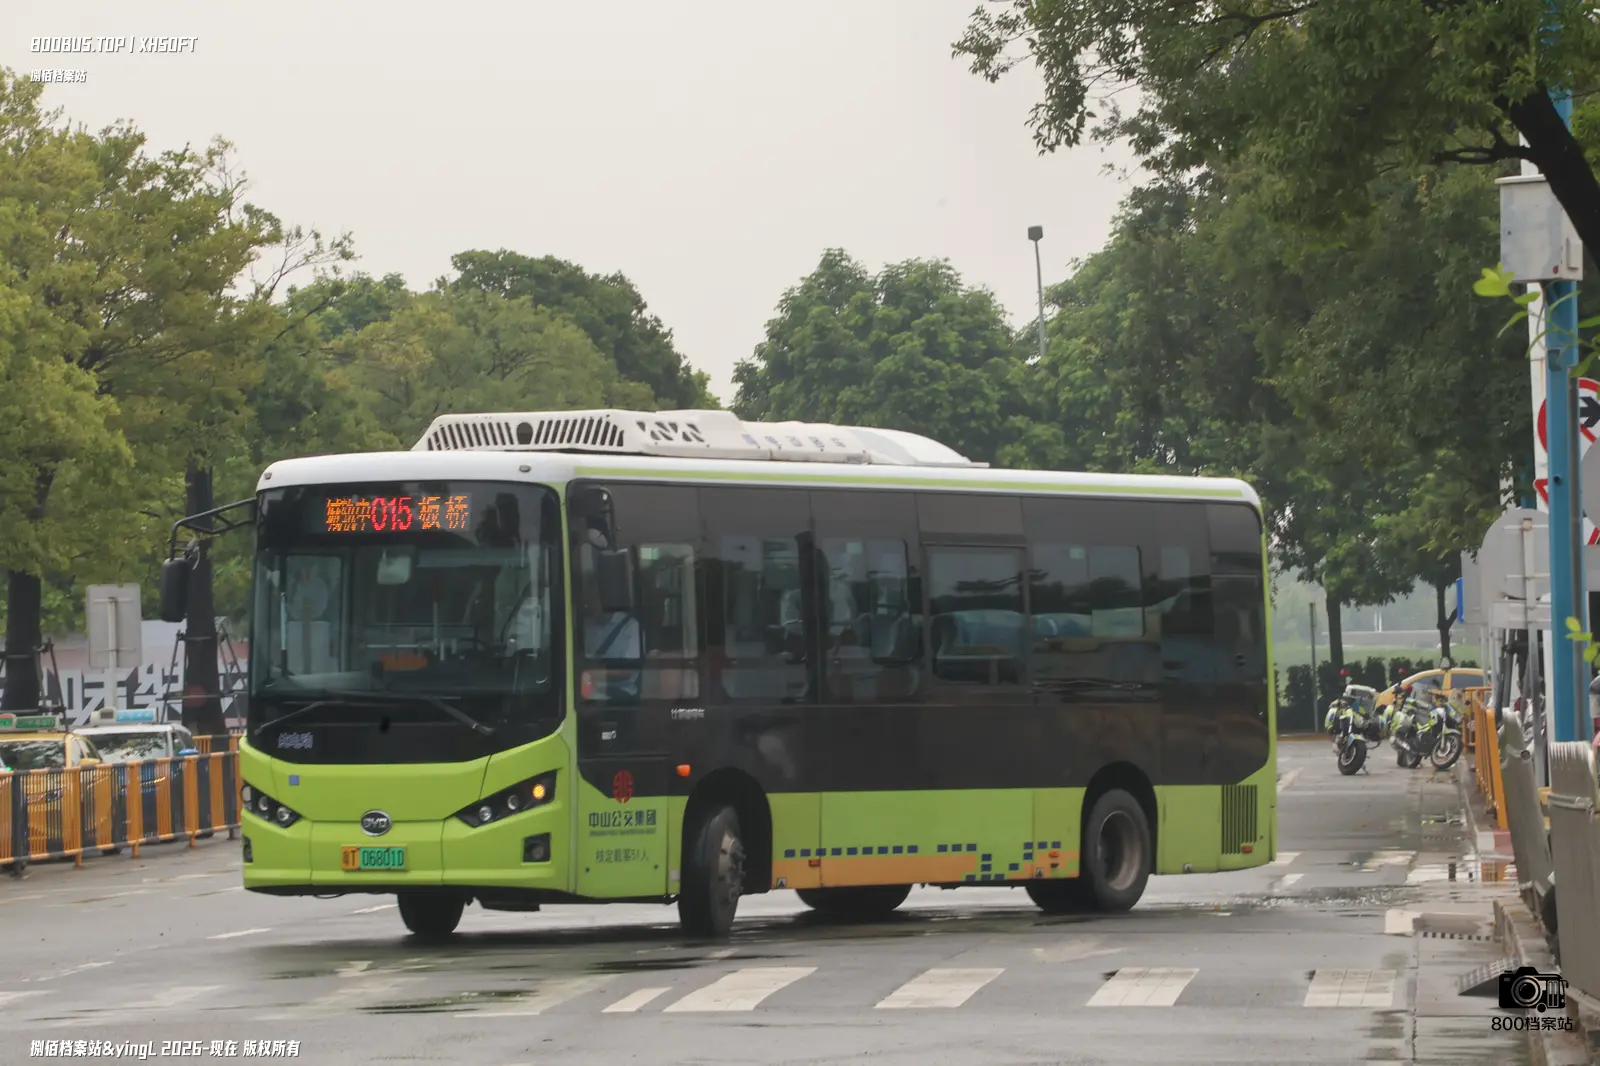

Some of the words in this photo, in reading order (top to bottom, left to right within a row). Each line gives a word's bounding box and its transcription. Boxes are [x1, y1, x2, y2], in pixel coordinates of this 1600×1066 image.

[370, 497, 413, 531] 015
[363, 817, 388, 829] BYD
[588, 809, 657, 828] 中山公交集团
